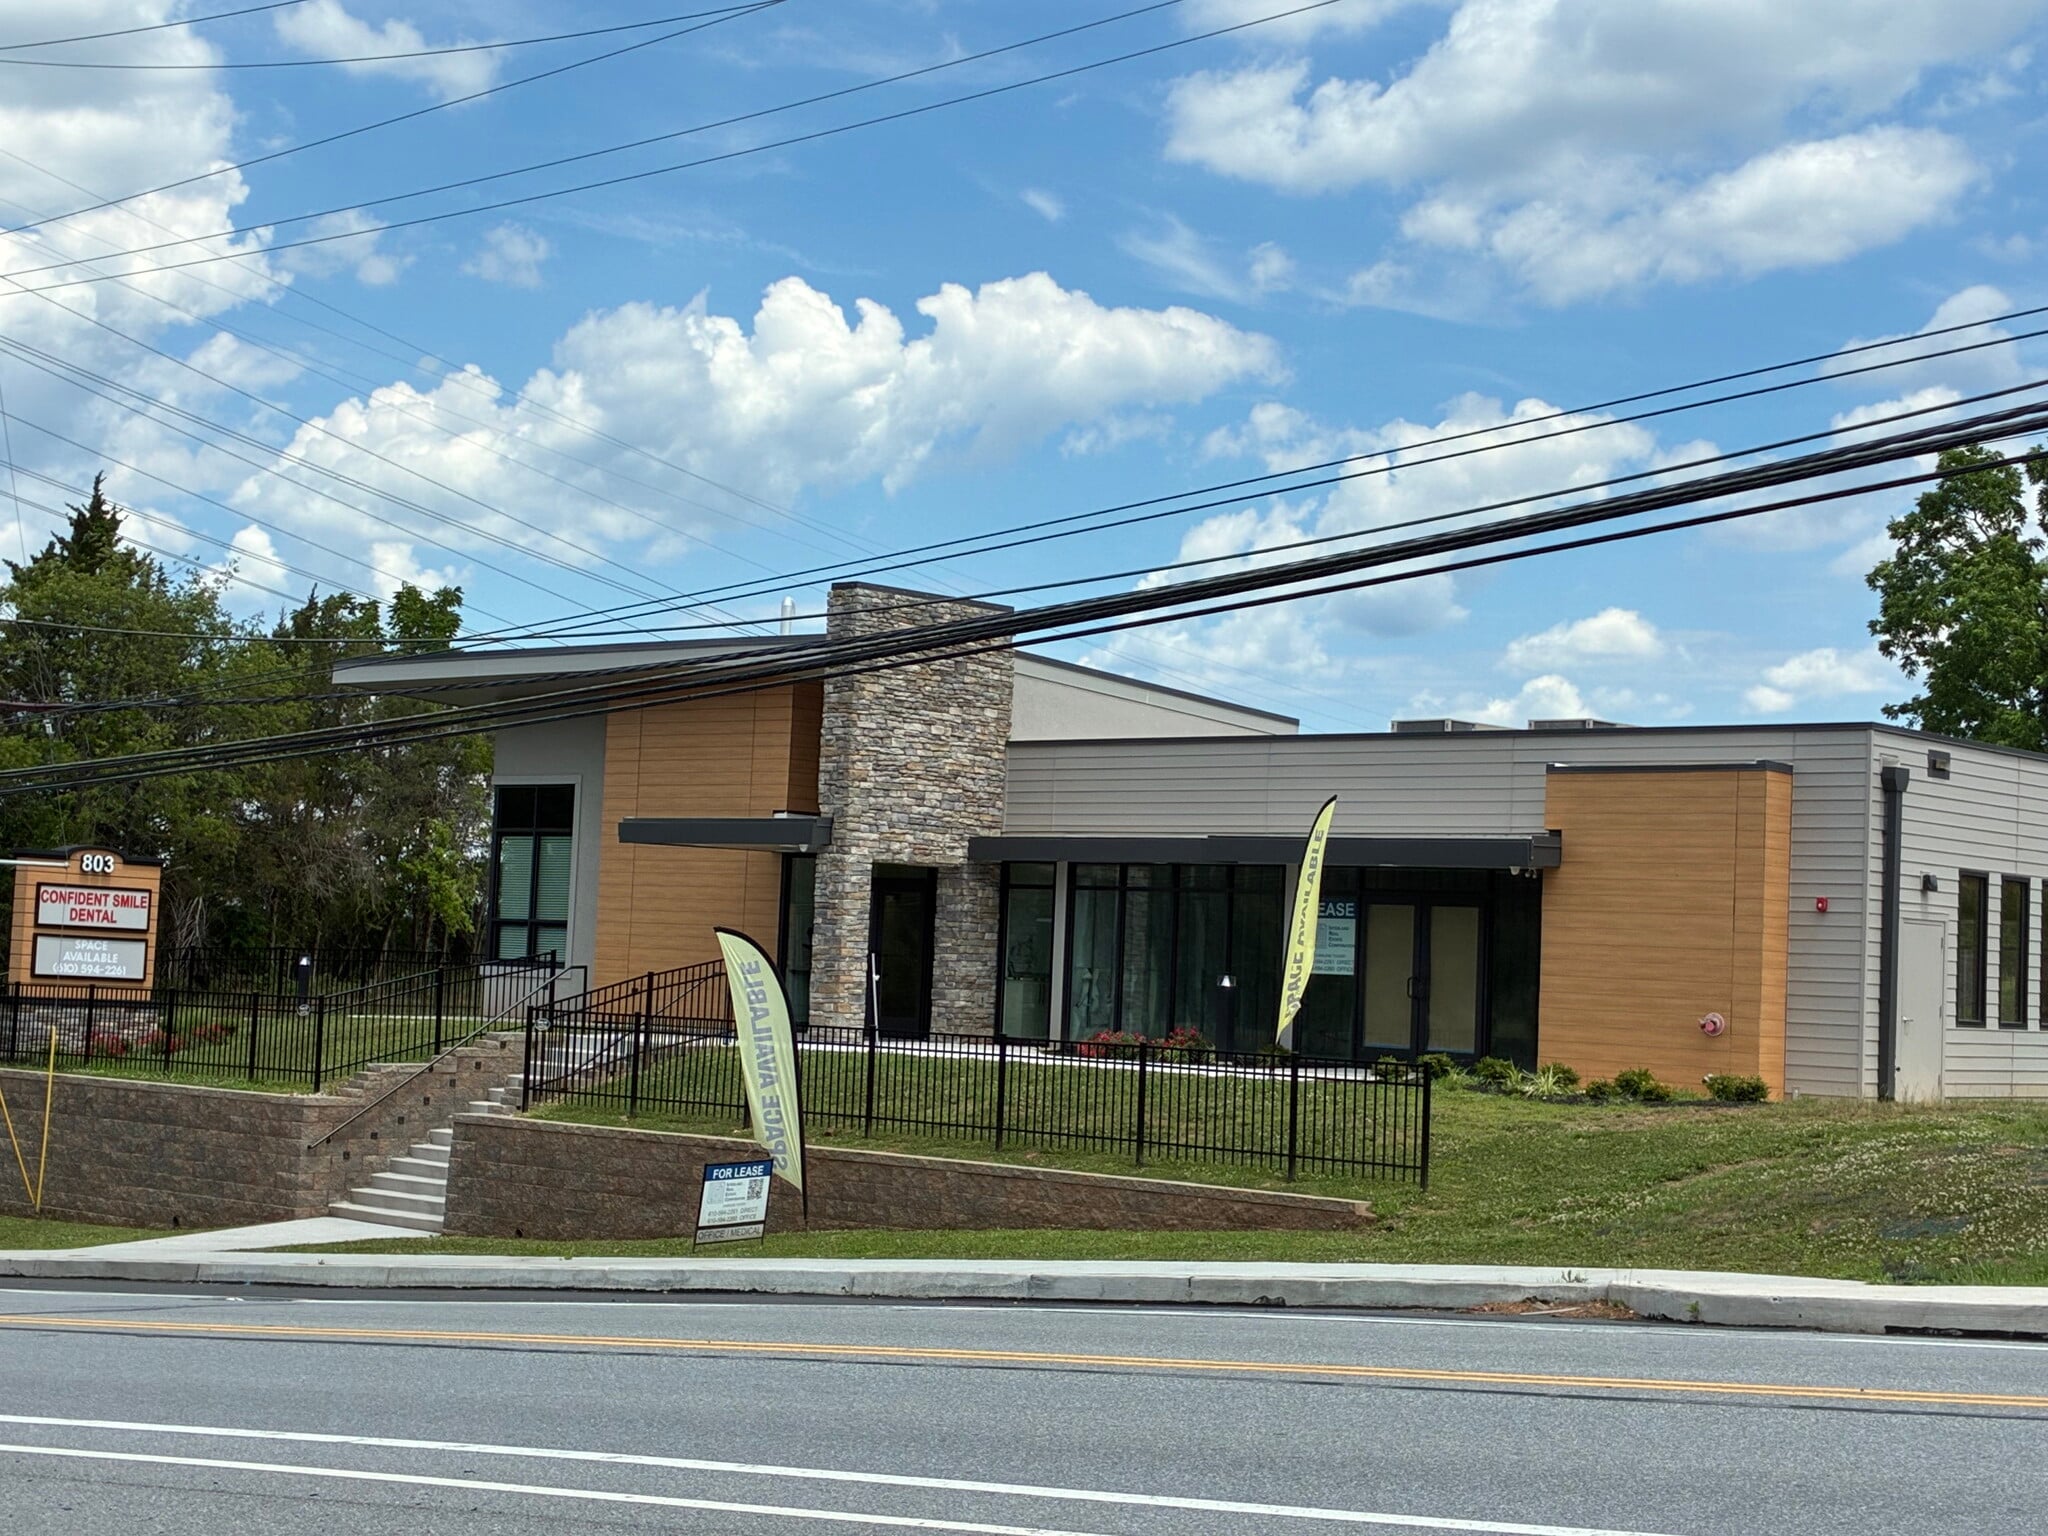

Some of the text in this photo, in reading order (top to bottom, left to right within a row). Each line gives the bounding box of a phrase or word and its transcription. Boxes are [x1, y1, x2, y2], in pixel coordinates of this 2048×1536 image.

[82, 854, 114, 873] 803
[40, 889, 148, 909] CONFIDENT SMILE
[69, 908, 117, 923] DENTAL
[1318, 902, 1355, 917] EASE
[75, 939, 108, 951] SPACE
[63, 951, 119, 964] AVAILABLE
[80, 964, 126, 976] 594-2261
[712, 1165, 764, 1180] FOR LEASE
